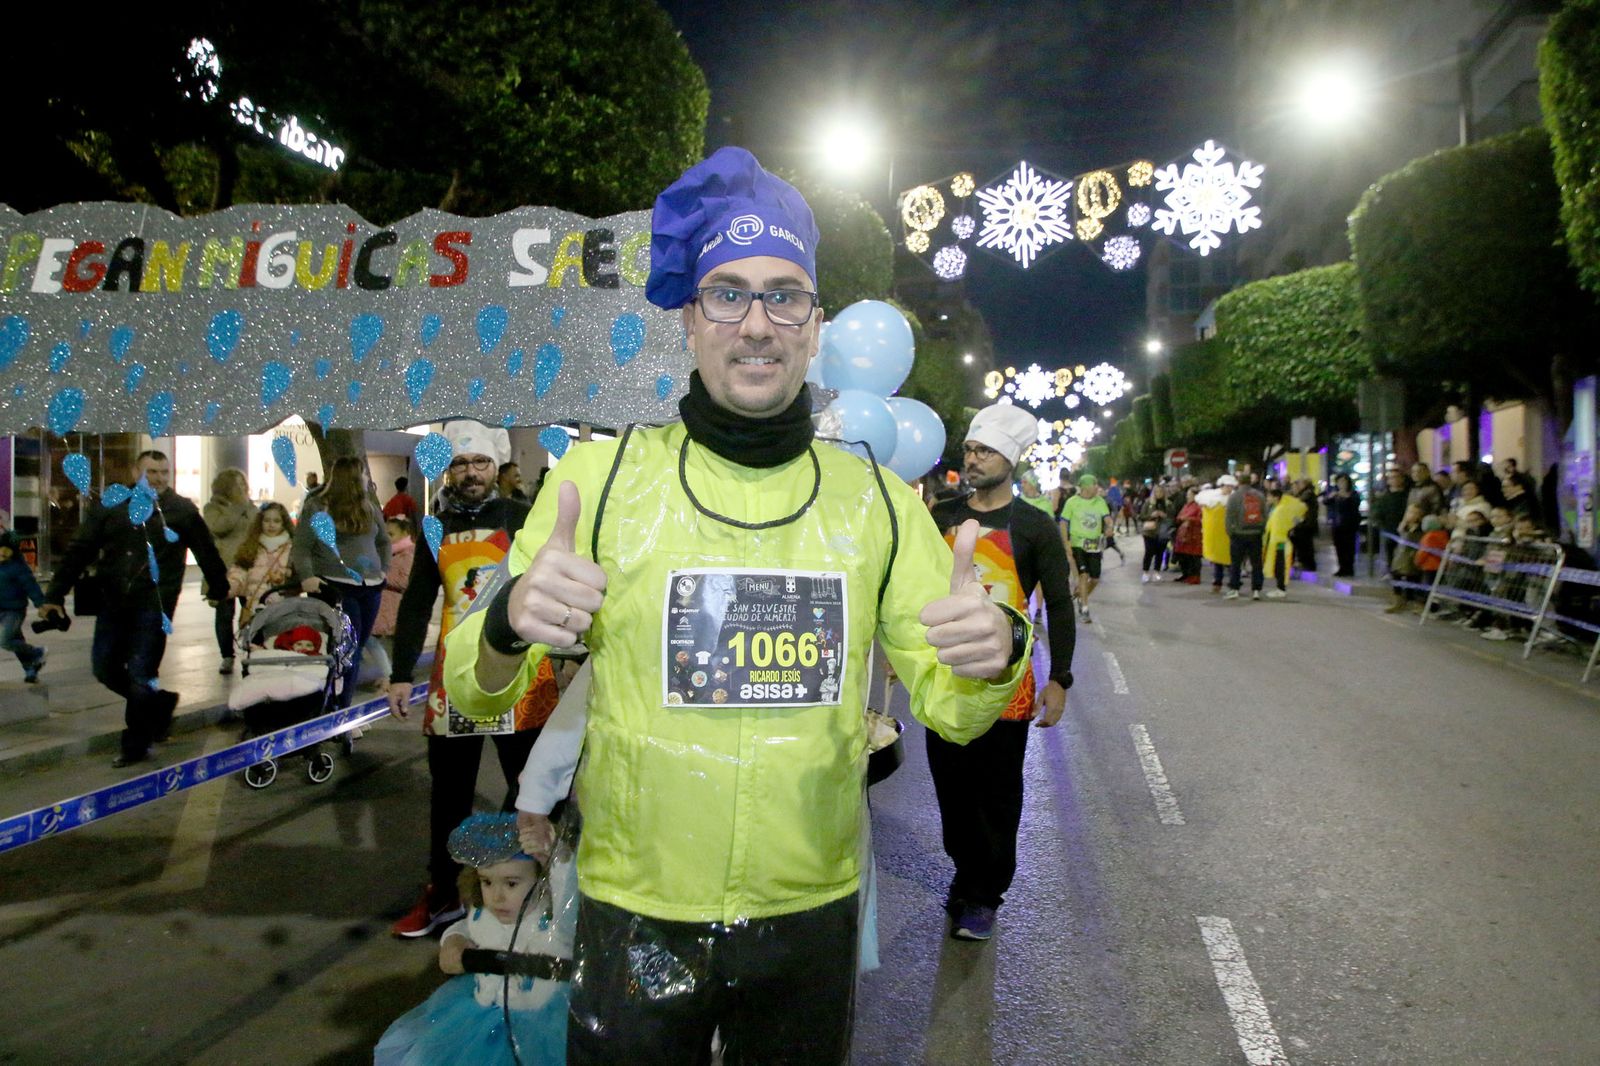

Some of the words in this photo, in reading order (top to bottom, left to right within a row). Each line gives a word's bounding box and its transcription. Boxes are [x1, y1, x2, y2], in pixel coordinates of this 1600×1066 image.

[1, 232, 192, 295] PEGAN
[732, 603, 749, 613] SAN
[751, 602, 798, 614] SILVESTRE
[751, 613, 762, 622] DE
[728, 632, 819, 667] 1066
[749, 670, 780, 682] RICARDO
[781, 668, 801, 682] JESÚS
[739, 683, 793, 699] asisa
